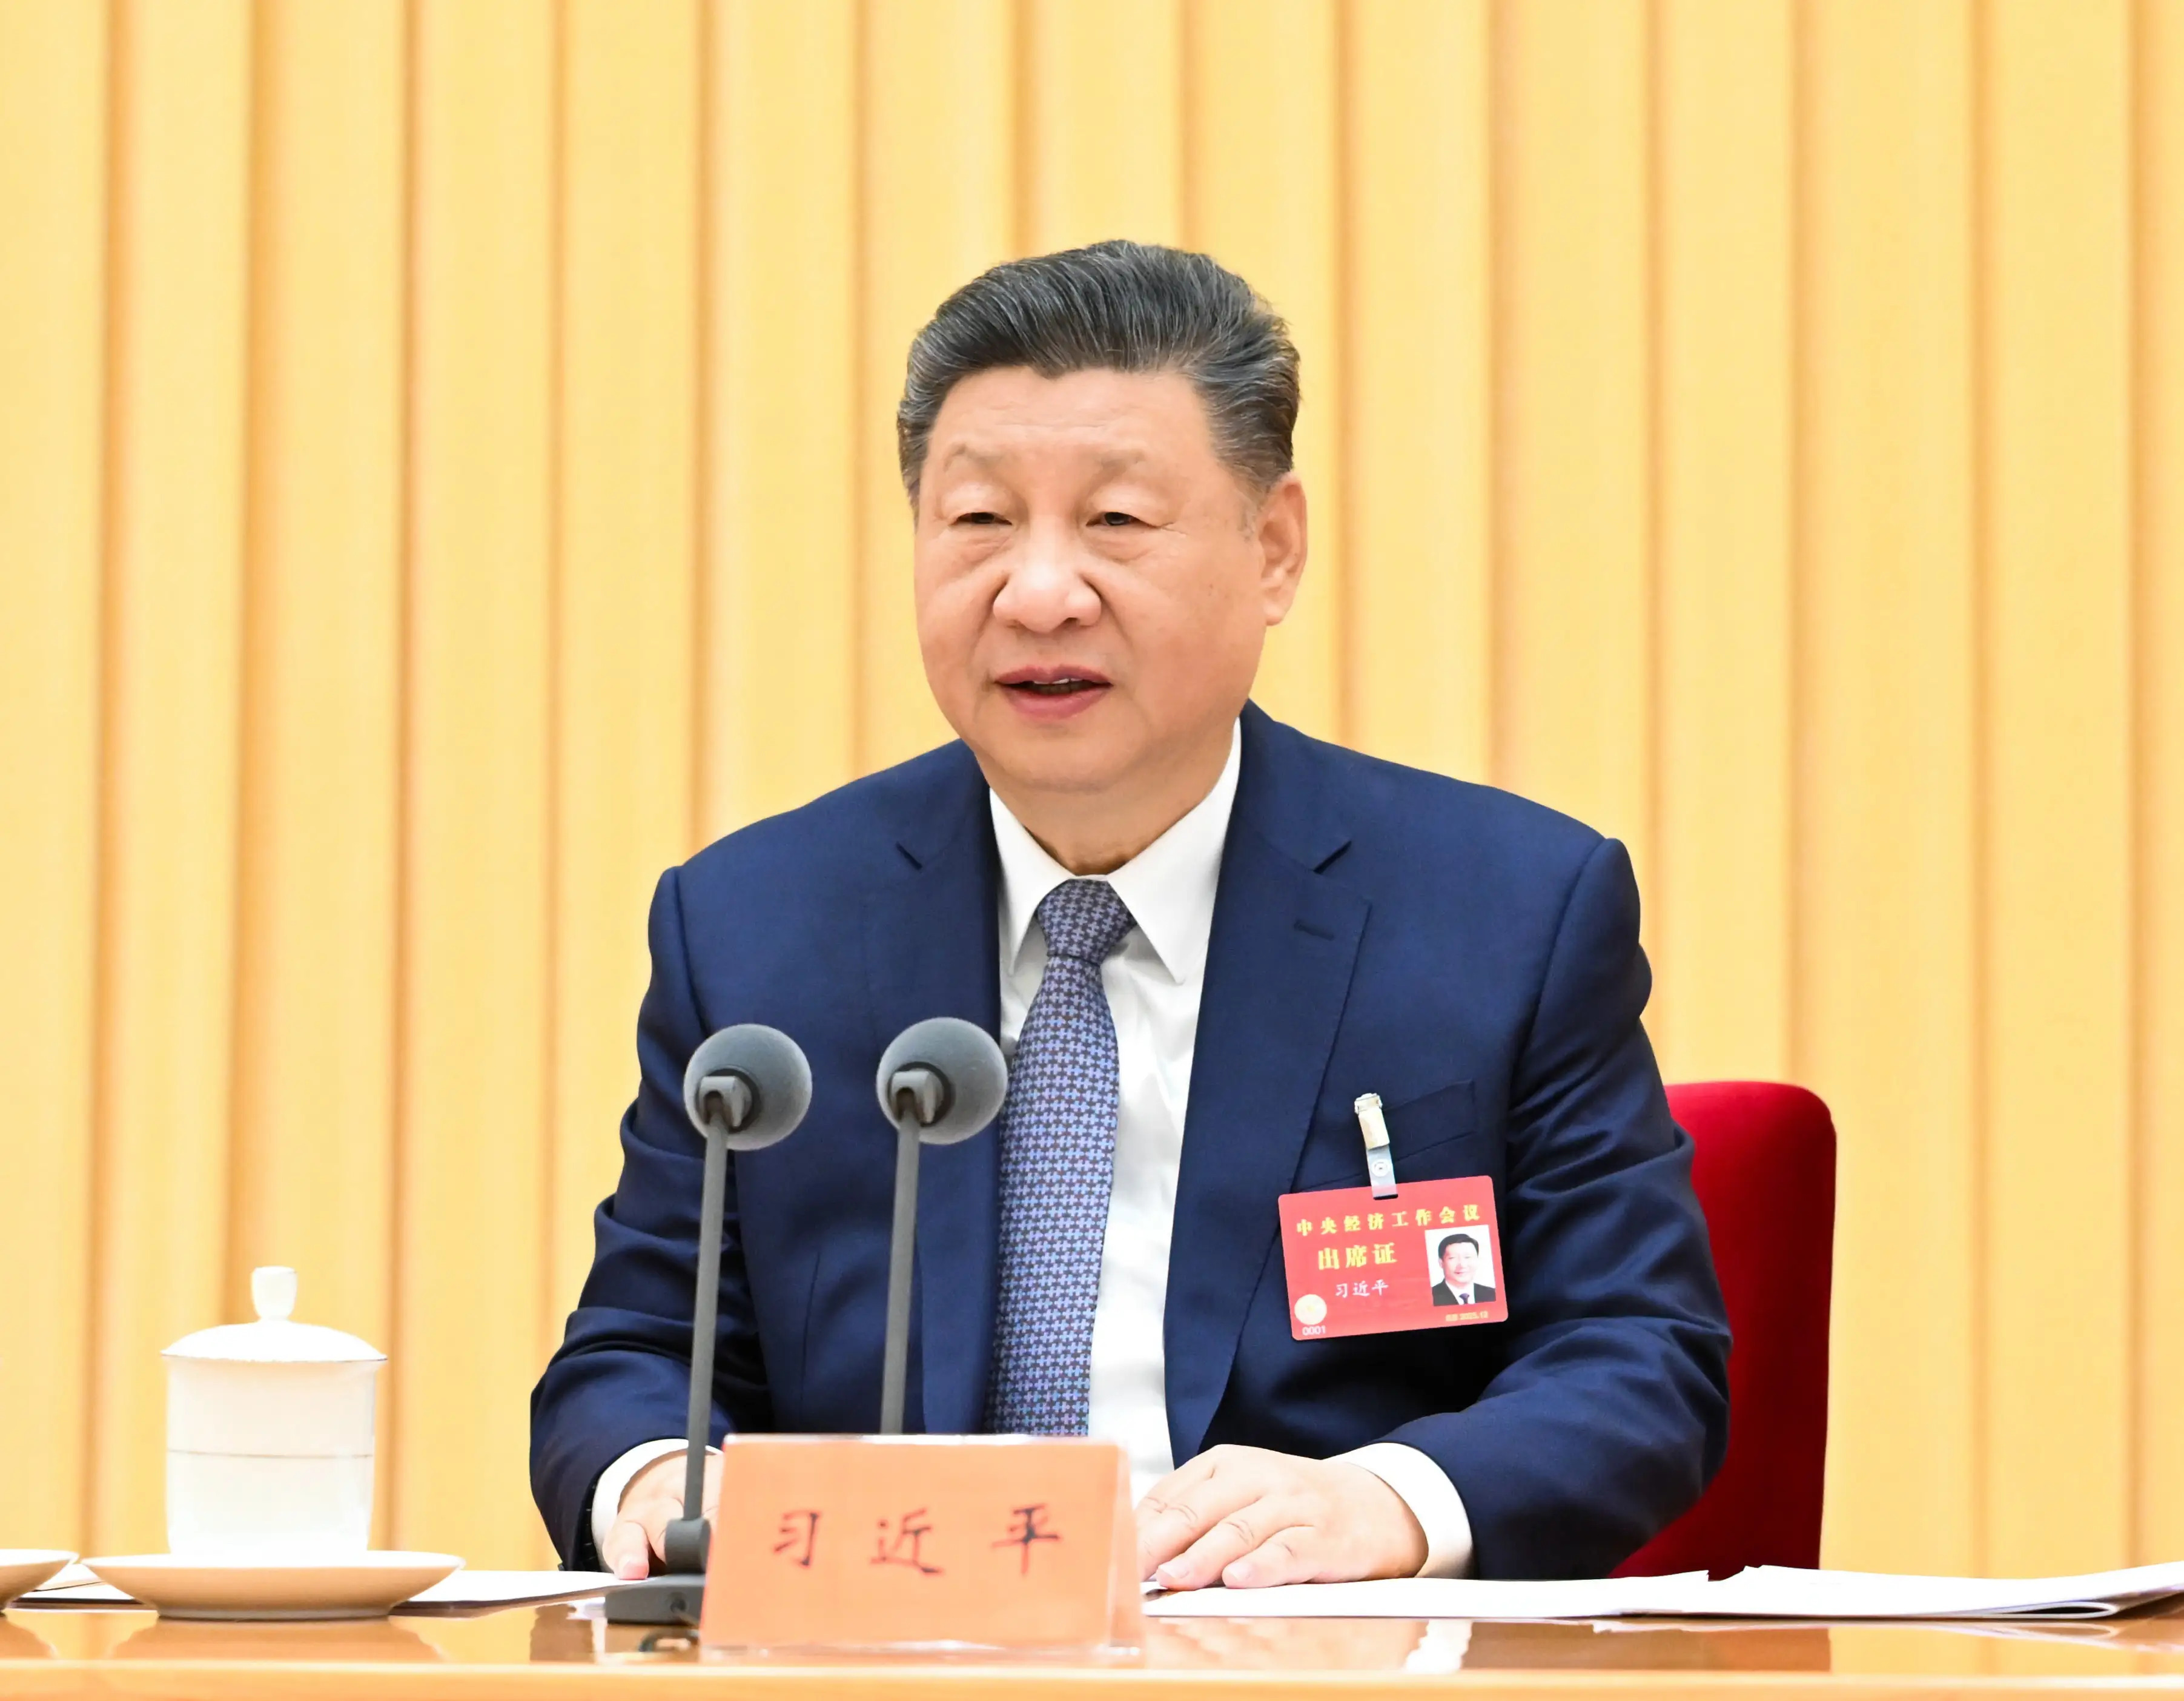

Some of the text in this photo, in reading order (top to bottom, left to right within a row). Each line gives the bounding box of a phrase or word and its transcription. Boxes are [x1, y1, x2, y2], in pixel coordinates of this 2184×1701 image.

[1297, 1204, 1480, 1236] 中央经济工作会议
[1318, 1242, 1397, 1270] 出席证
[1335, 1279, 1389, 1298] 习近平
[1302, 1325, 1326, 1336] 0001
[772, 1502, 1062, 1576] 习近平
